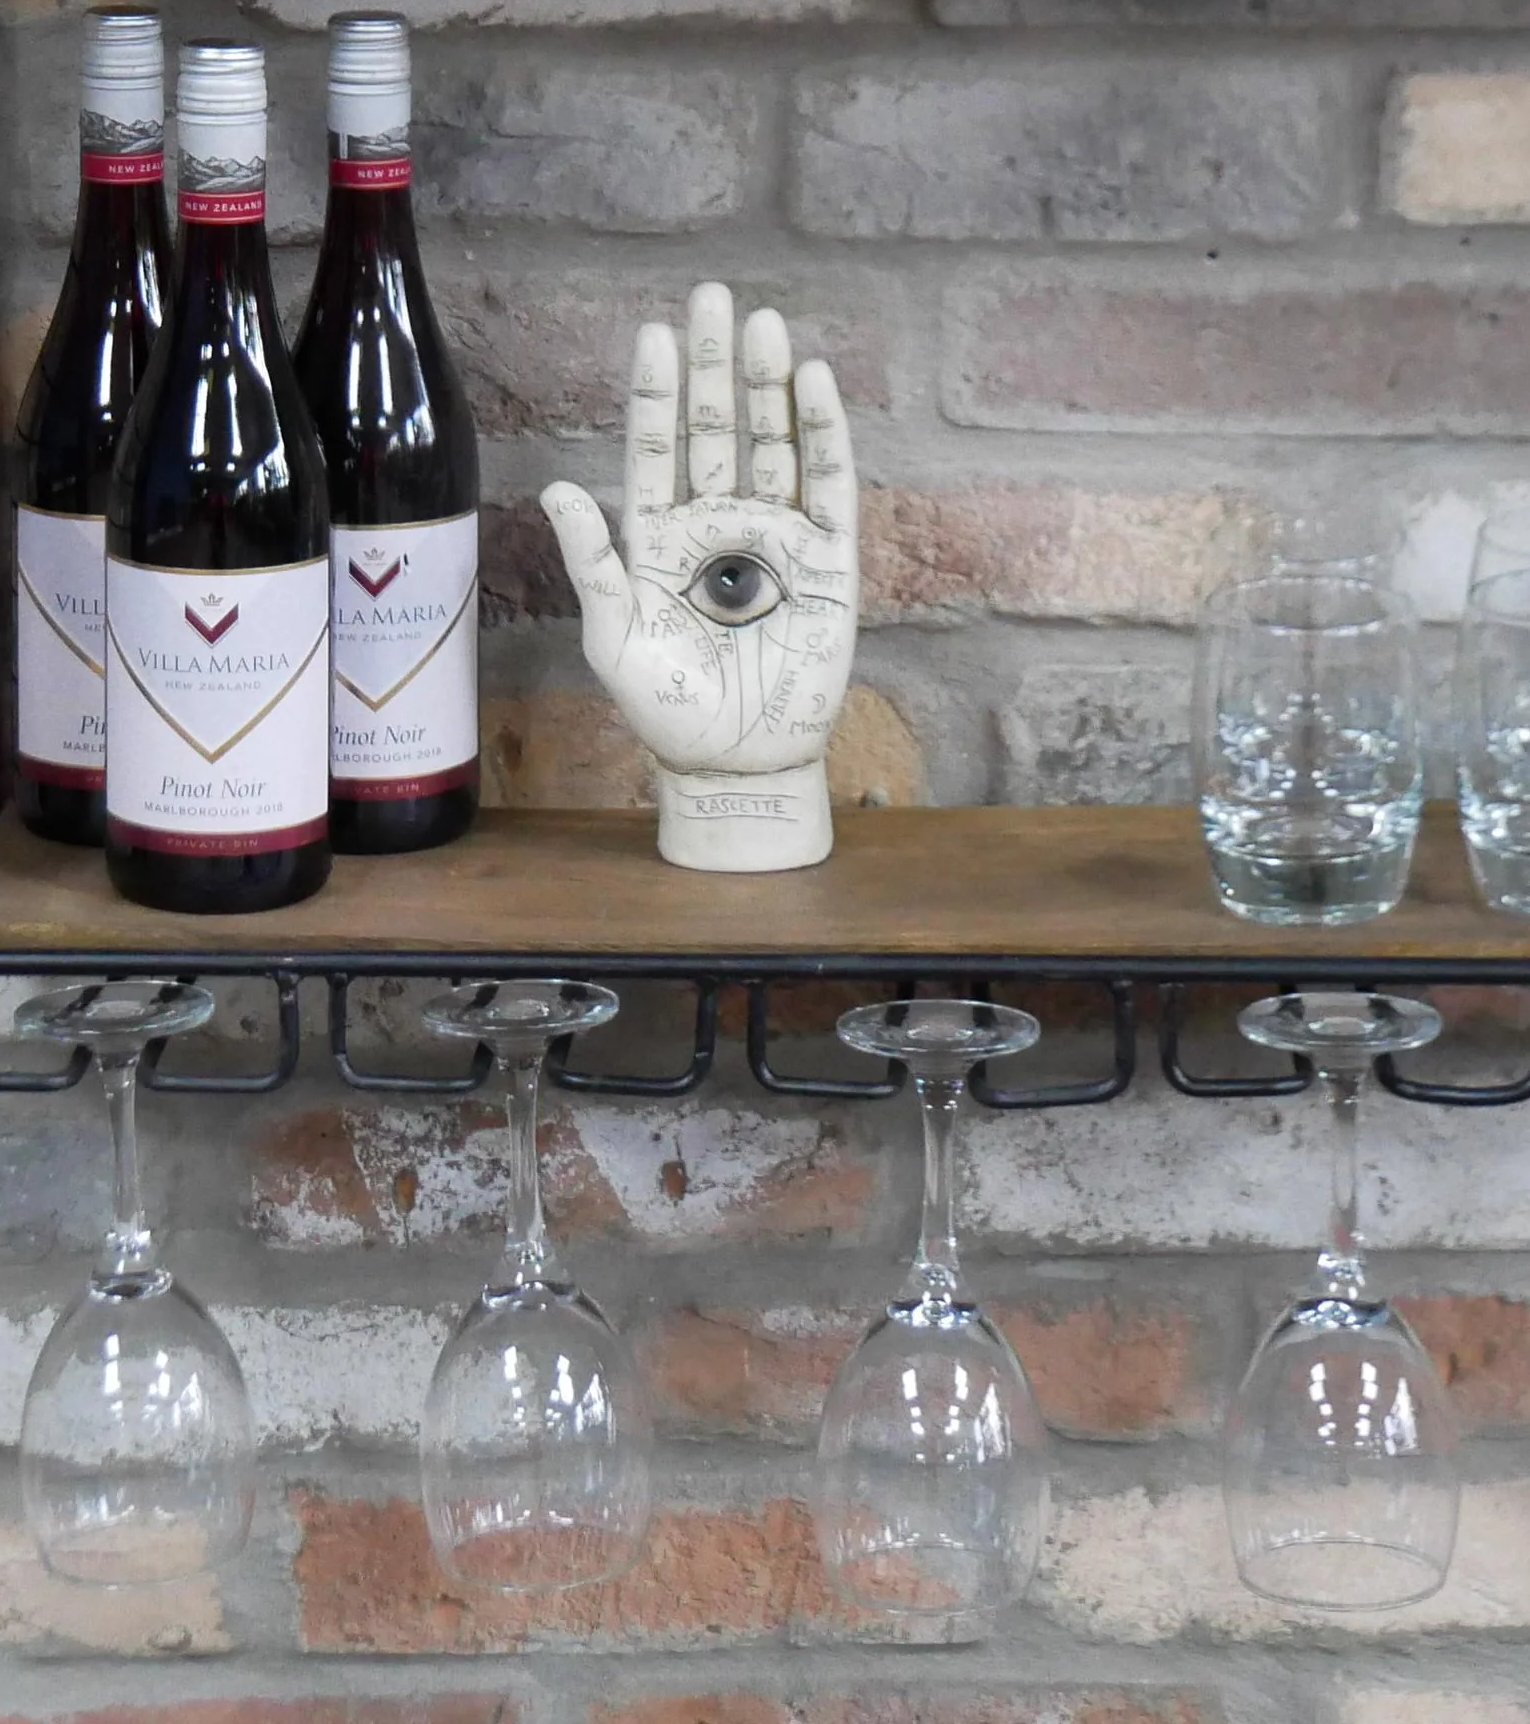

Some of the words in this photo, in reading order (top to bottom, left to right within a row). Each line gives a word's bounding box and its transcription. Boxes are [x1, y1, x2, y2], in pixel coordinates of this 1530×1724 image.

[108, 164, 135, 174] NEW
[357, 168, 384, 179] NEW
[185, 200, 209, 212] NEW
[213, 199, 262, 213] ZEALAND
[576, 577, 621, 596] WILL
[373, 604, 448, 625] MARIA
[362, 630, 422, 642] ZEALAND
[138, 647, 203, 674] VILLA
[209, 652, 291, 674] MARIA
[165, 679, 193, 691] NEW
[198, 679, 262, 691] ZEALAND
[383, 723, 427, 745] Noir
[416, 746, 442, 760] 2018
[159, 775, 213, 799] Pinot
[221, 778, 268, 799] Noir
[396, 783, 420, 794] BIN
[143, 801, 251, 817] MARLBOROUGH
[256, 801, 284, 816] 2018
[695, 798, 786, 815] RASCETTE
[166, 838, 224, 849] PRIVATE
[233, 837, 260, 848] BIN
